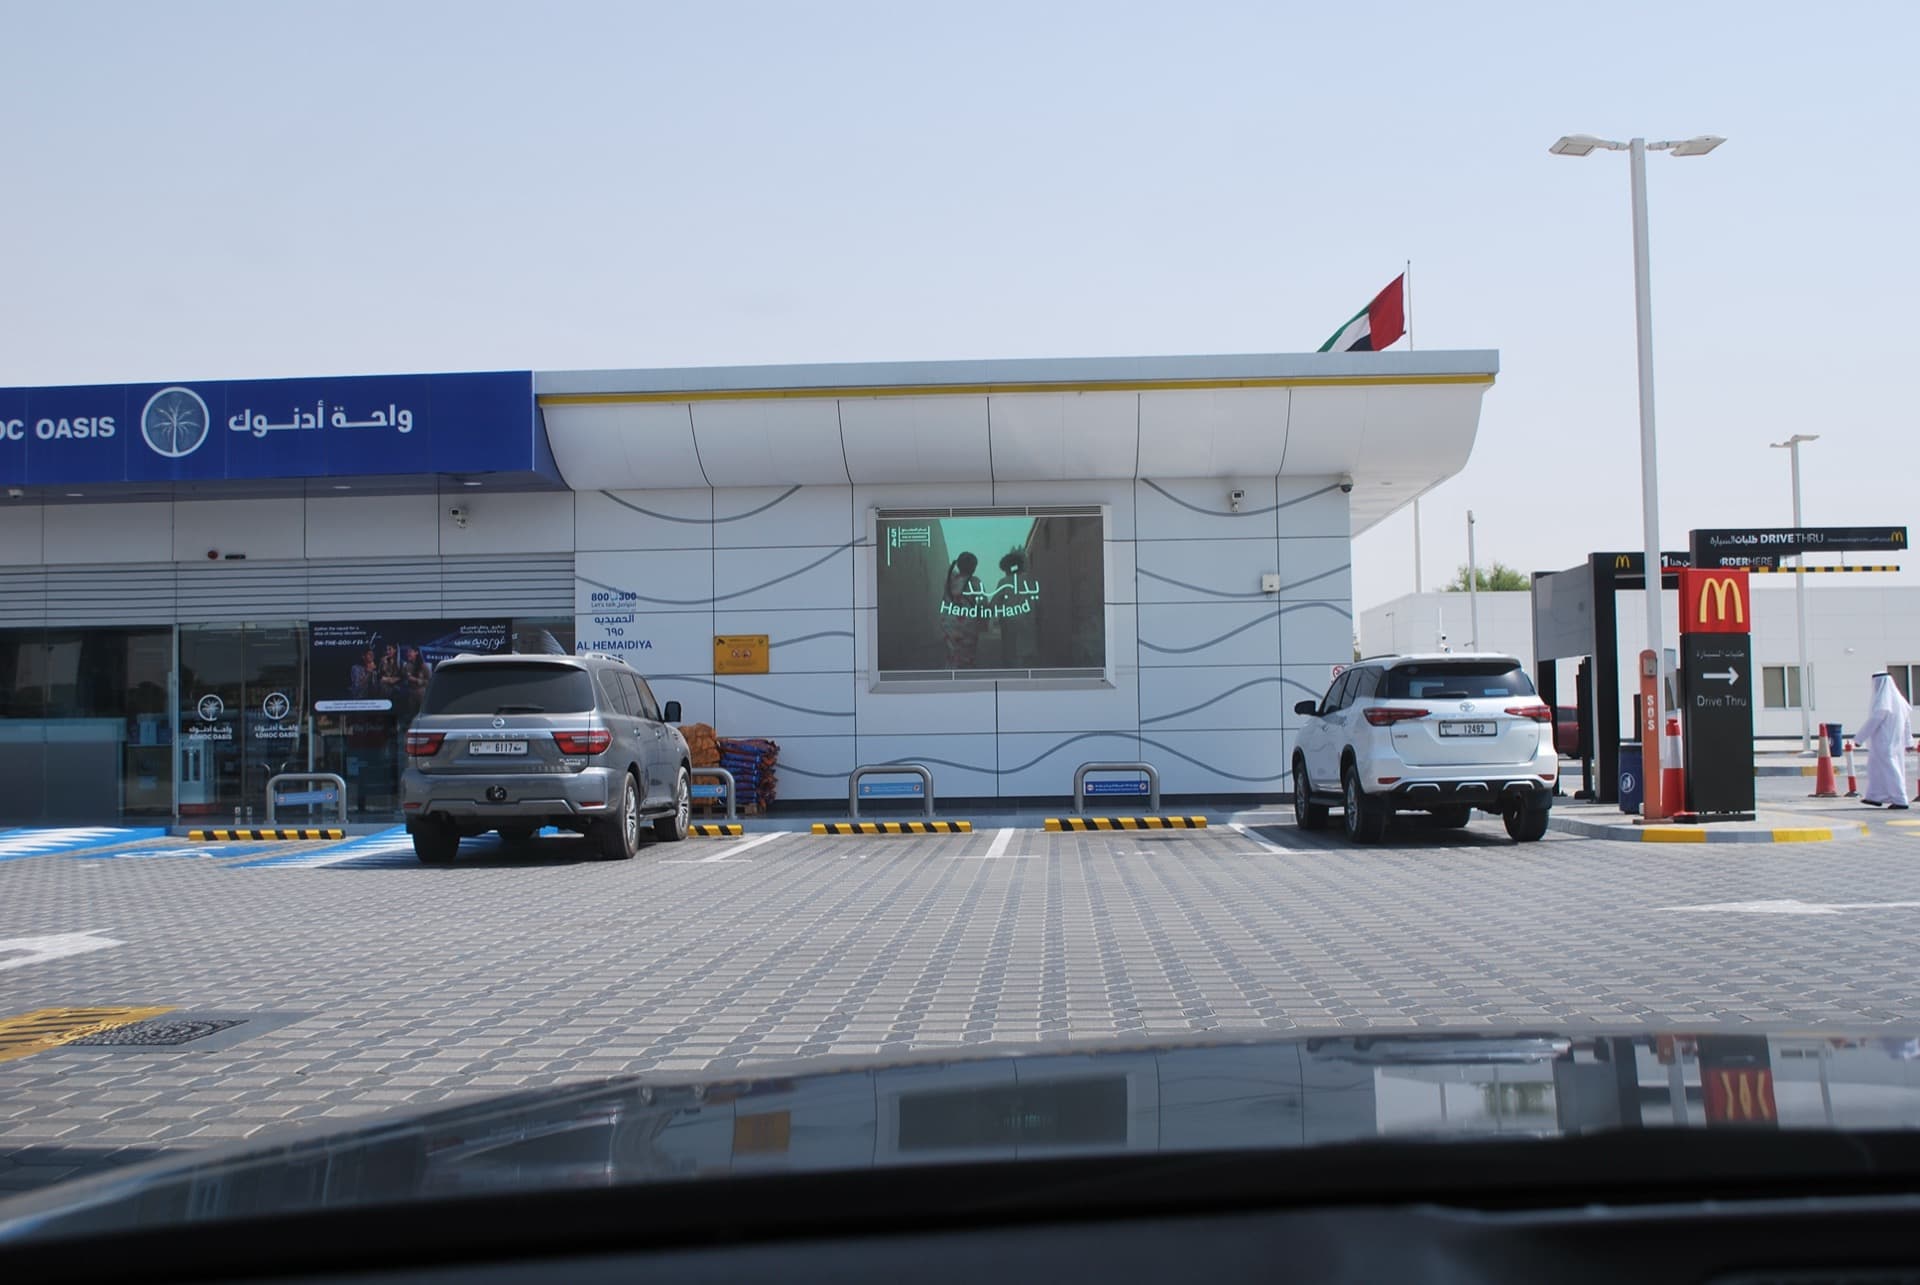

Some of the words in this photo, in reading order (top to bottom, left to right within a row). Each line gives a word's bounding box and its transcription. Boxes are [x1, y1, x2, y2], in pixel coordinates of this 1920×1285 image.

[228, 399, 324, 438] أدنوك
[331, 404, 413, 433] واحة
[36, 416, 115, 440] OASIS
[591, 592, 609, 601] 800
[619, 592, 637, 601] 300
[940, 600, 978, 618] Hand
[980, 605, 992, 618] in
[994, 599, 1031, 617] Hand
[577, 641, 589, 650] AL
[593, 640, 652, 650] HEMAIDIYA
[1697, 695, 1722, 706] Drive
[1725, 695, 1747, 706] Thru
[1463, 725, 1485, 734] 12492
